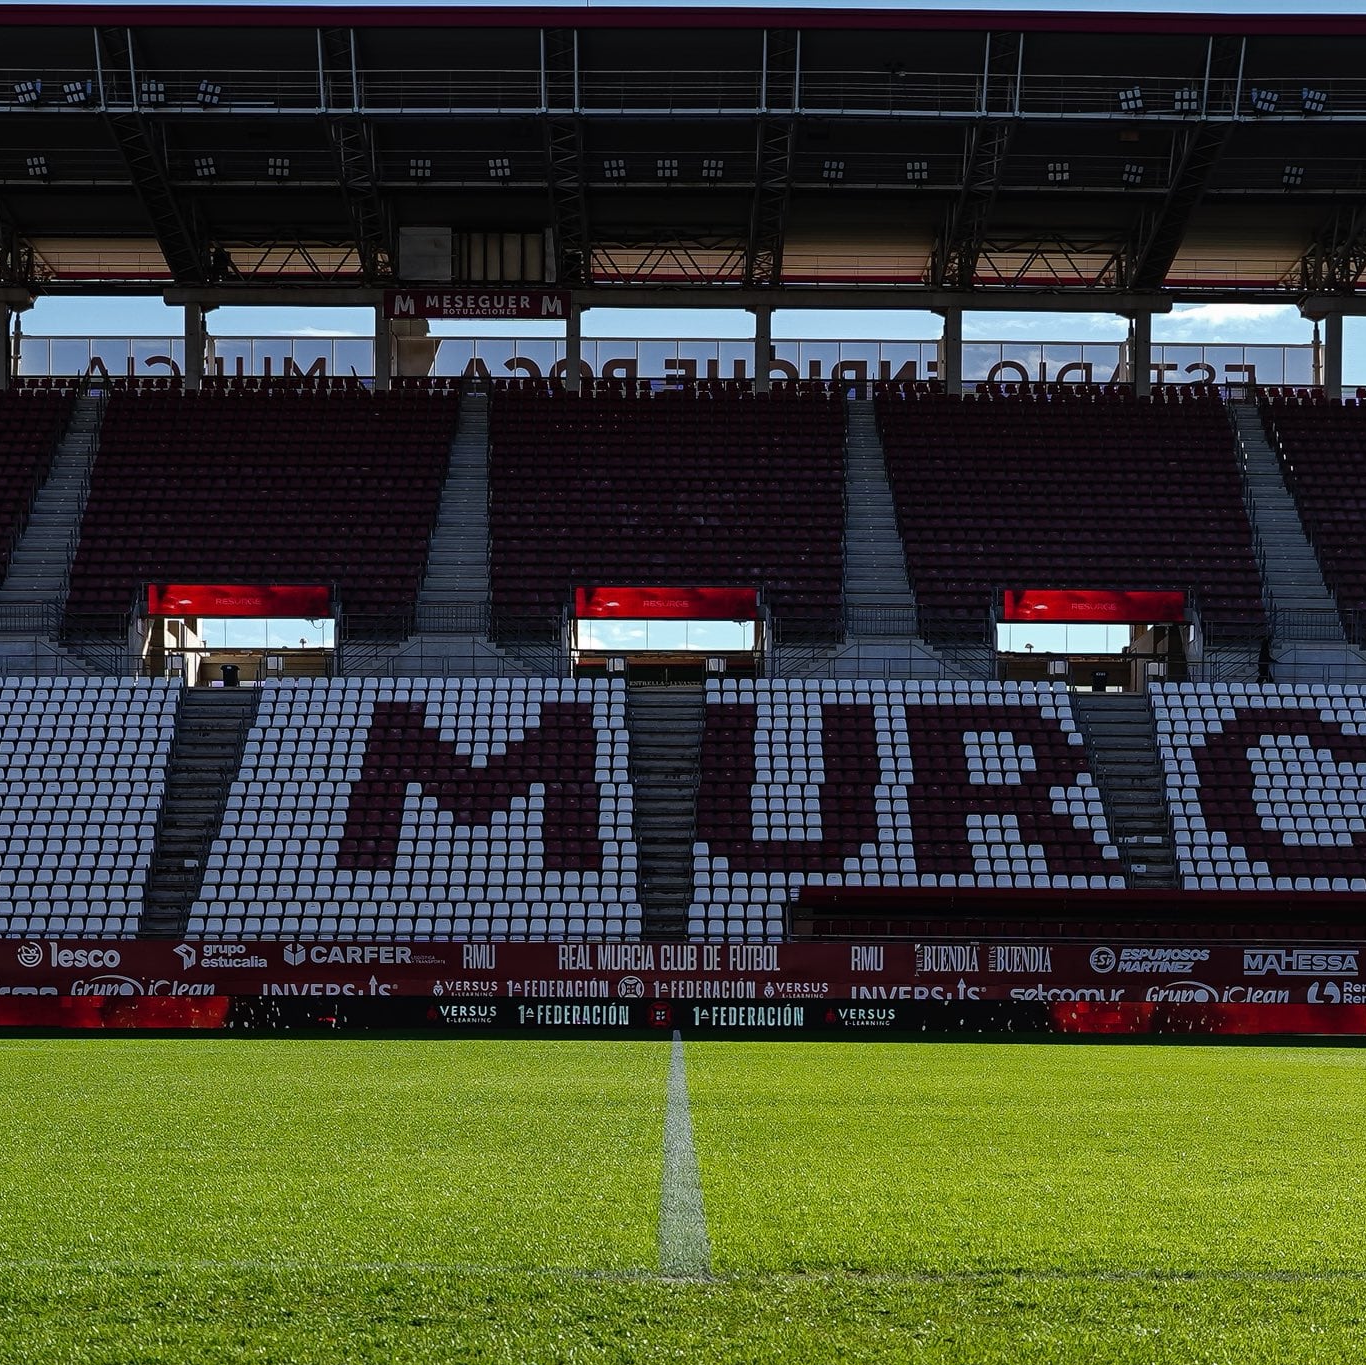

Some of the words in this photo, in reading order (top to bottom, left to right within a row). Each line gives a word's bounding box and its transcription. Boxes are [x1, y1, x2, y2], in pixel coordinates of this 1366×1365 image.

[425, 295, 530, 309] MESEGUER
[50, 942, 121, 968] lesco
[203, 943, 246, 957] grupo
[310, 946, 412, 964] CARFER
[463, 944, 496, 970] RMU
[558, 945, 594, 970] REAL
[597, 945, 655, 971] MURCIA
[660, 945, 698, 971] CLUB
[703, 945, 722, 971] DE
[729, 943, 781, 972] FÚTBOL
[850, 946, 884, 972] RMU
[923, 945, 980, 972] BUENDIA
[996, 946, 1053, 973] BUENDIA
[1119, 949, 1210, 962] ESPUMOSOS
[201, 955, 268, 968] estucalia
[1243, 950, 1360, 976] MAHESSA
[445, 980, 498, 991] VERSUS
[523, 977, 609, 998] FEDERACIÓN
[671, 978, 756, 999] FEDERACIÓN
[776, 982, 830, 993] VERSUS
[1010, 983, 1125, 1001] setcomur
[439, 1005, 498, 1017] VERSUS
[537, 1002, 629, 1026] FEDERACIÓN
[712, 1004, 805, 1027] FEDERACIÓN
[838, 1007, 896, 1020] VERSUS
